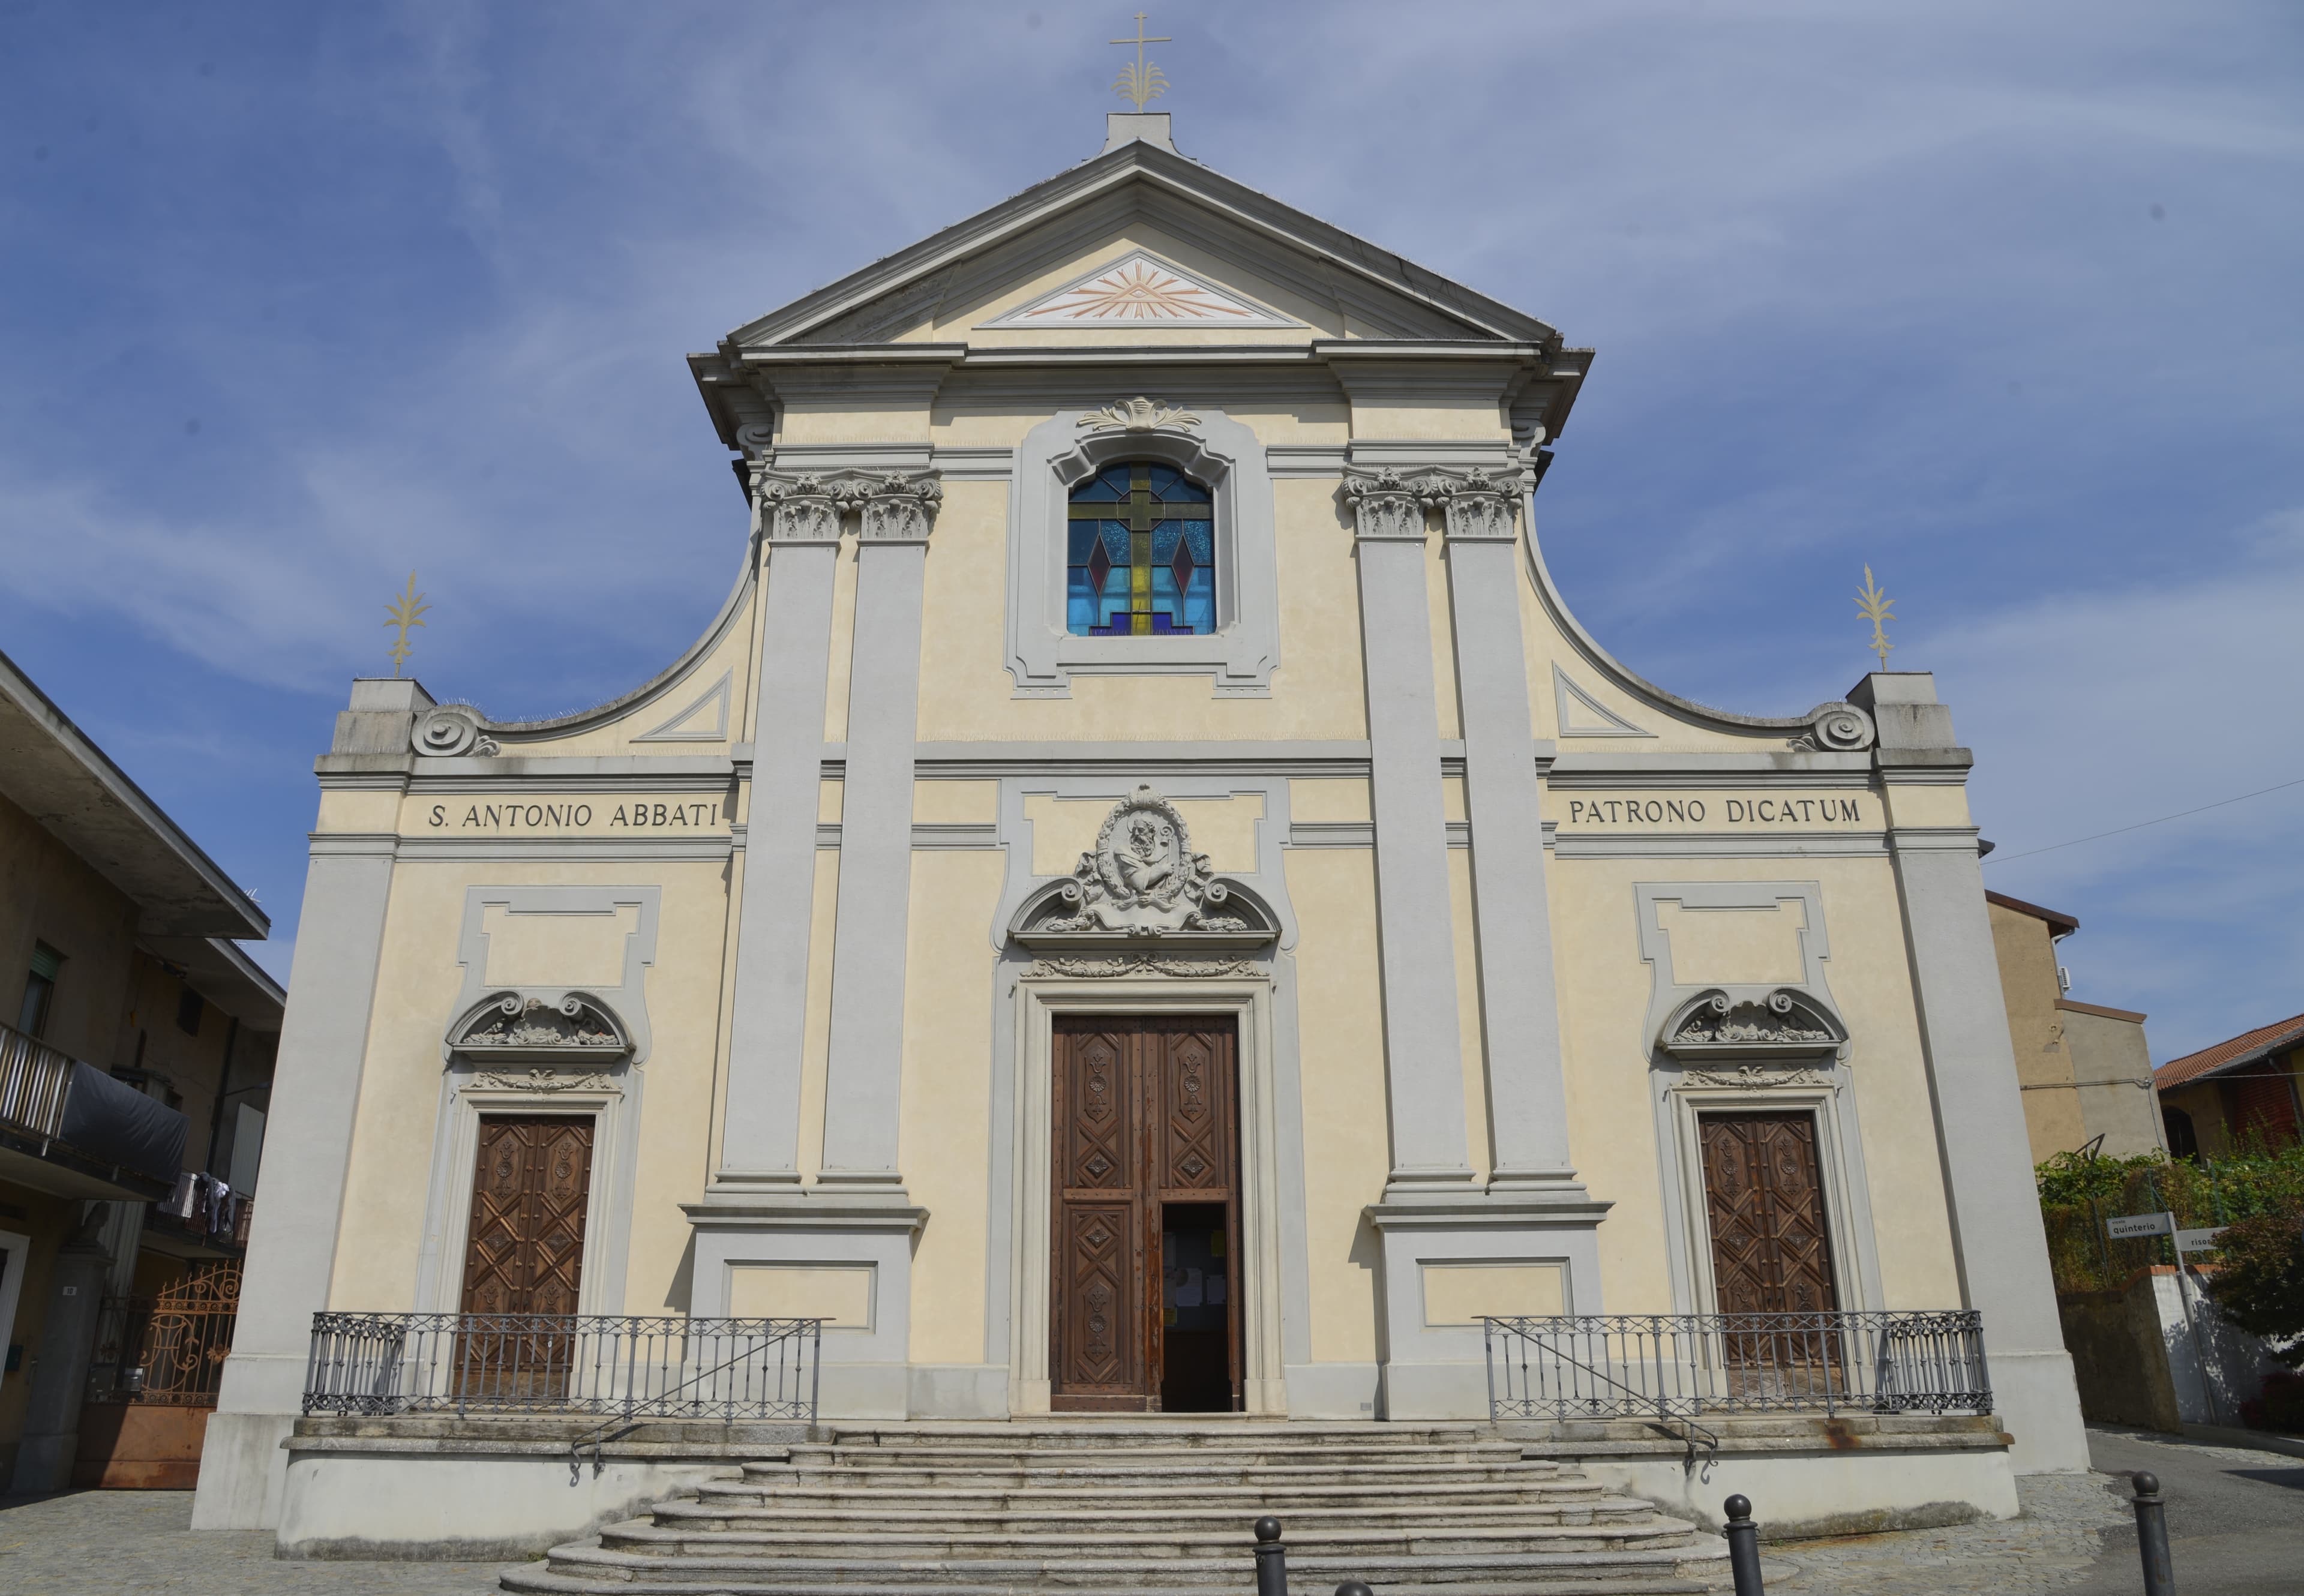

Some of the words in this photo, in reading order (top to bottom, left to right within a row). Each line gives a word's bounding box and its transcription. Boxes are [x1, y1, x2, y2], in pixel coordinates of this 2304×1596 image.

[429, 805, 449, 827] S.
[462, 805, 592, 827] ANTONIO
[610, 803, 718, 826] ABBATI
[1570, 800, 1705, 823] PATRONO
[1726, 799, 1861, 822] DICATUM
[2113, 1223, 2155, 1234] quinterio
